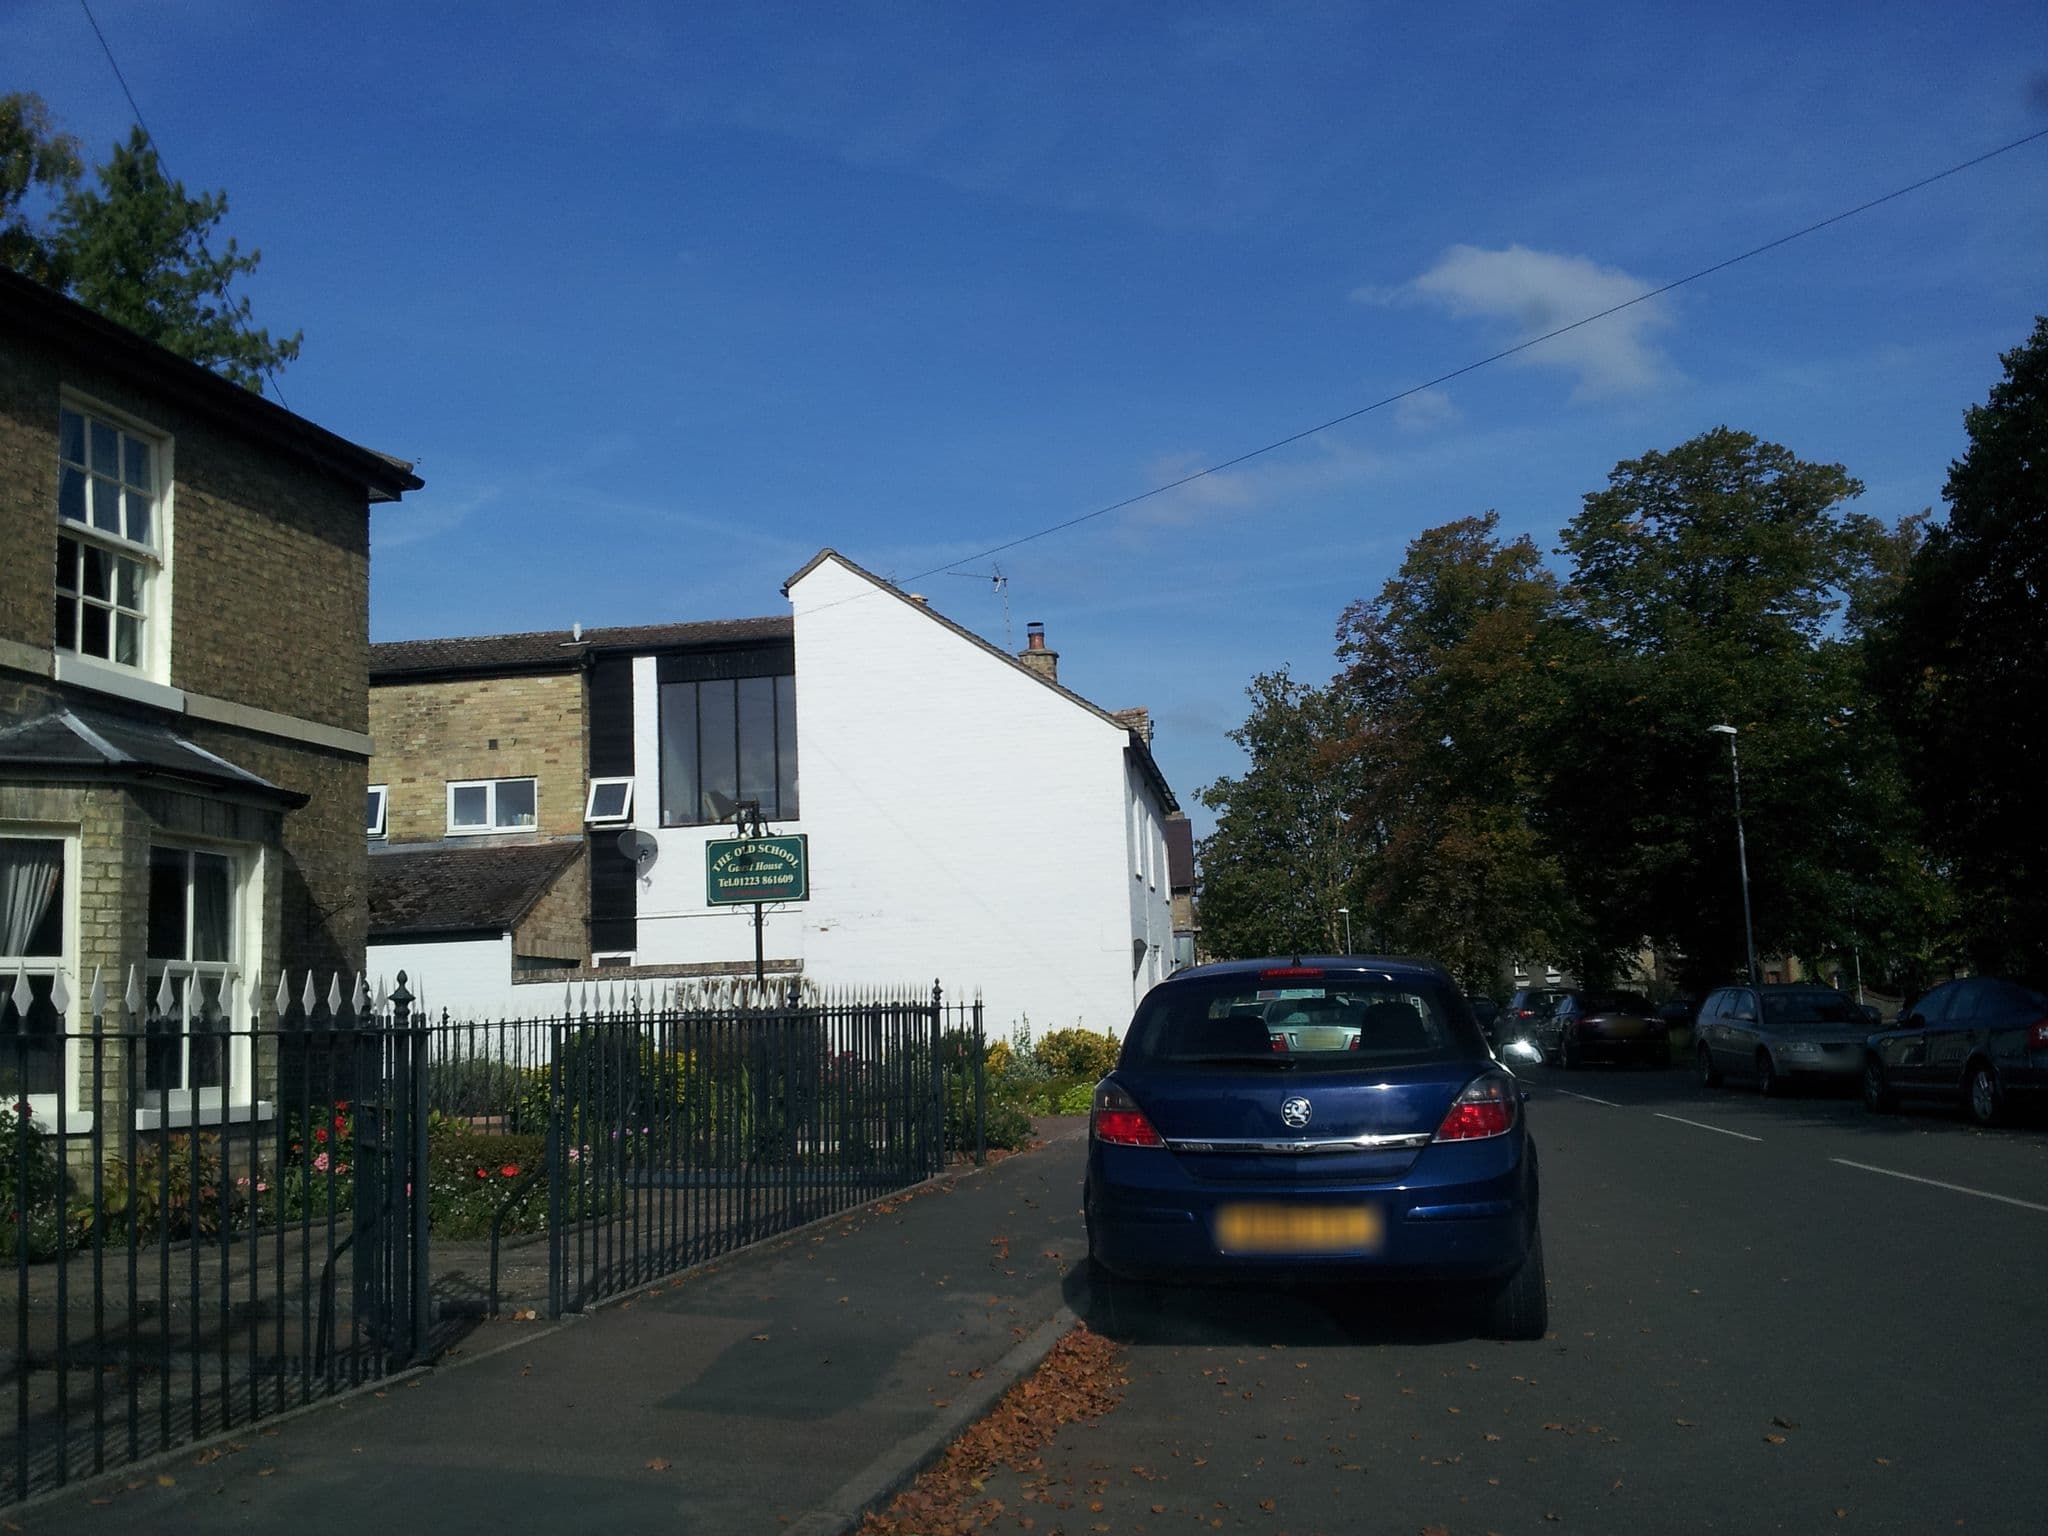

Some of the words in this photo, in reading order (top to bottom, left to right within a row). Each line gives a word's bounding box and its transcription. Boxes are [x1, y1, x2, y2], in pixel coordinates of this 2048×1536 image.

[712, 852, 733, 873] THE
[734, 845, 756, 857] OLD
[758, 844, 799, 868] SCHOOL
[755, 861, 783, 871] House
[762, 874, 794, 885] 861609
